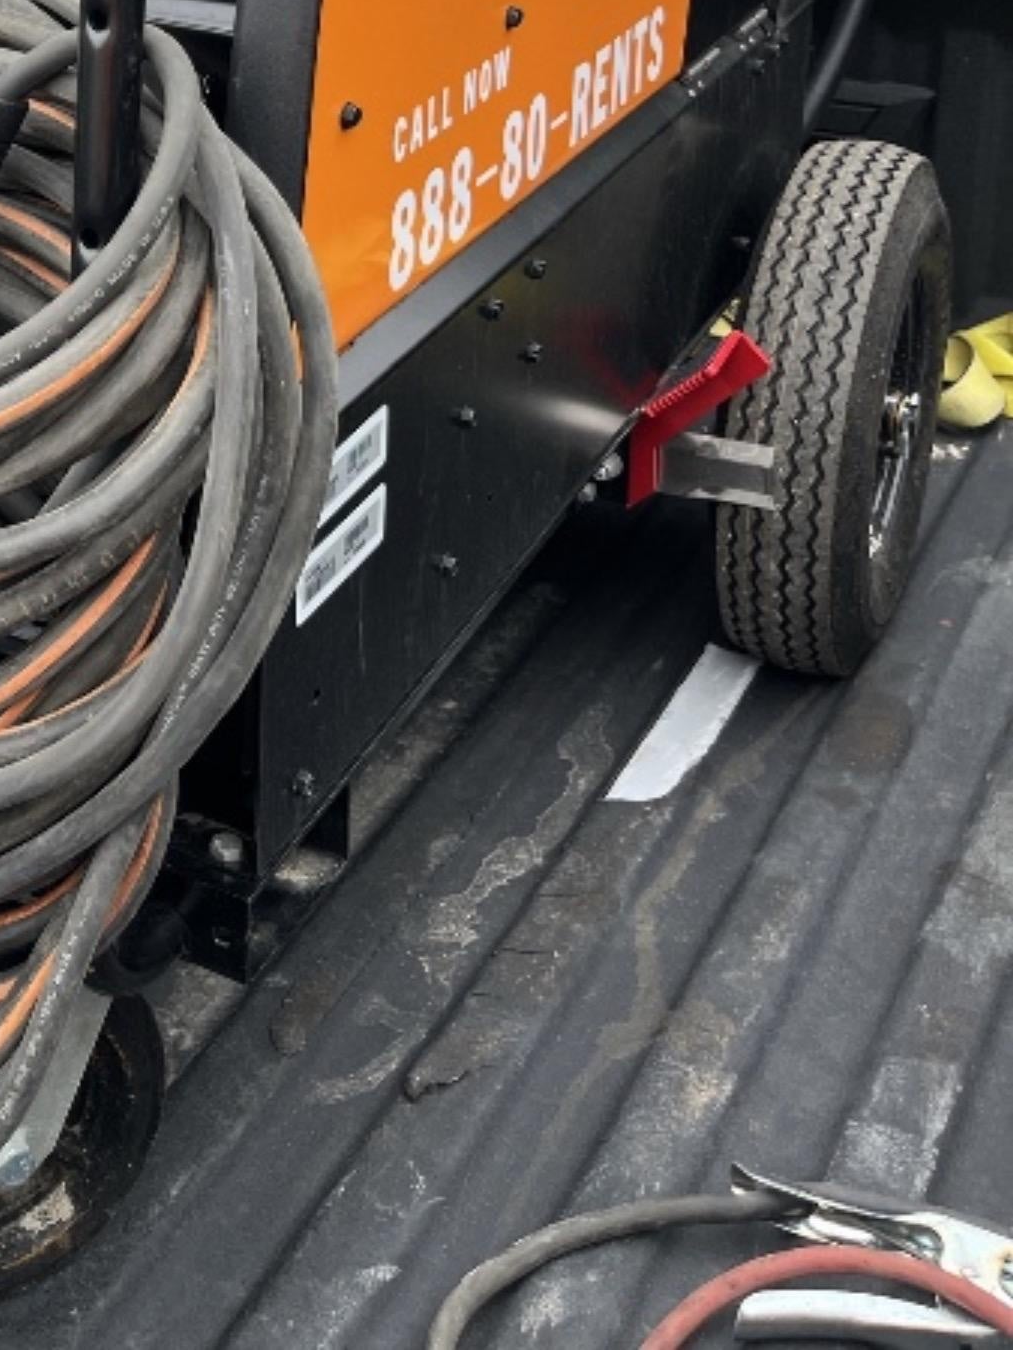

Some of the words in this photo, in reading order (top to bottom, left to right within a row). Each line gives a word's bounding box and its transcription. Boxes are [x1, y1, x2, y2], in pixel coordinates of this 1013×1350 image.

[388, 4, 666, 293] 888-80-RENTS
[393, 85, 454, 163] CALL
[463, 44, 512, 116] NOW
